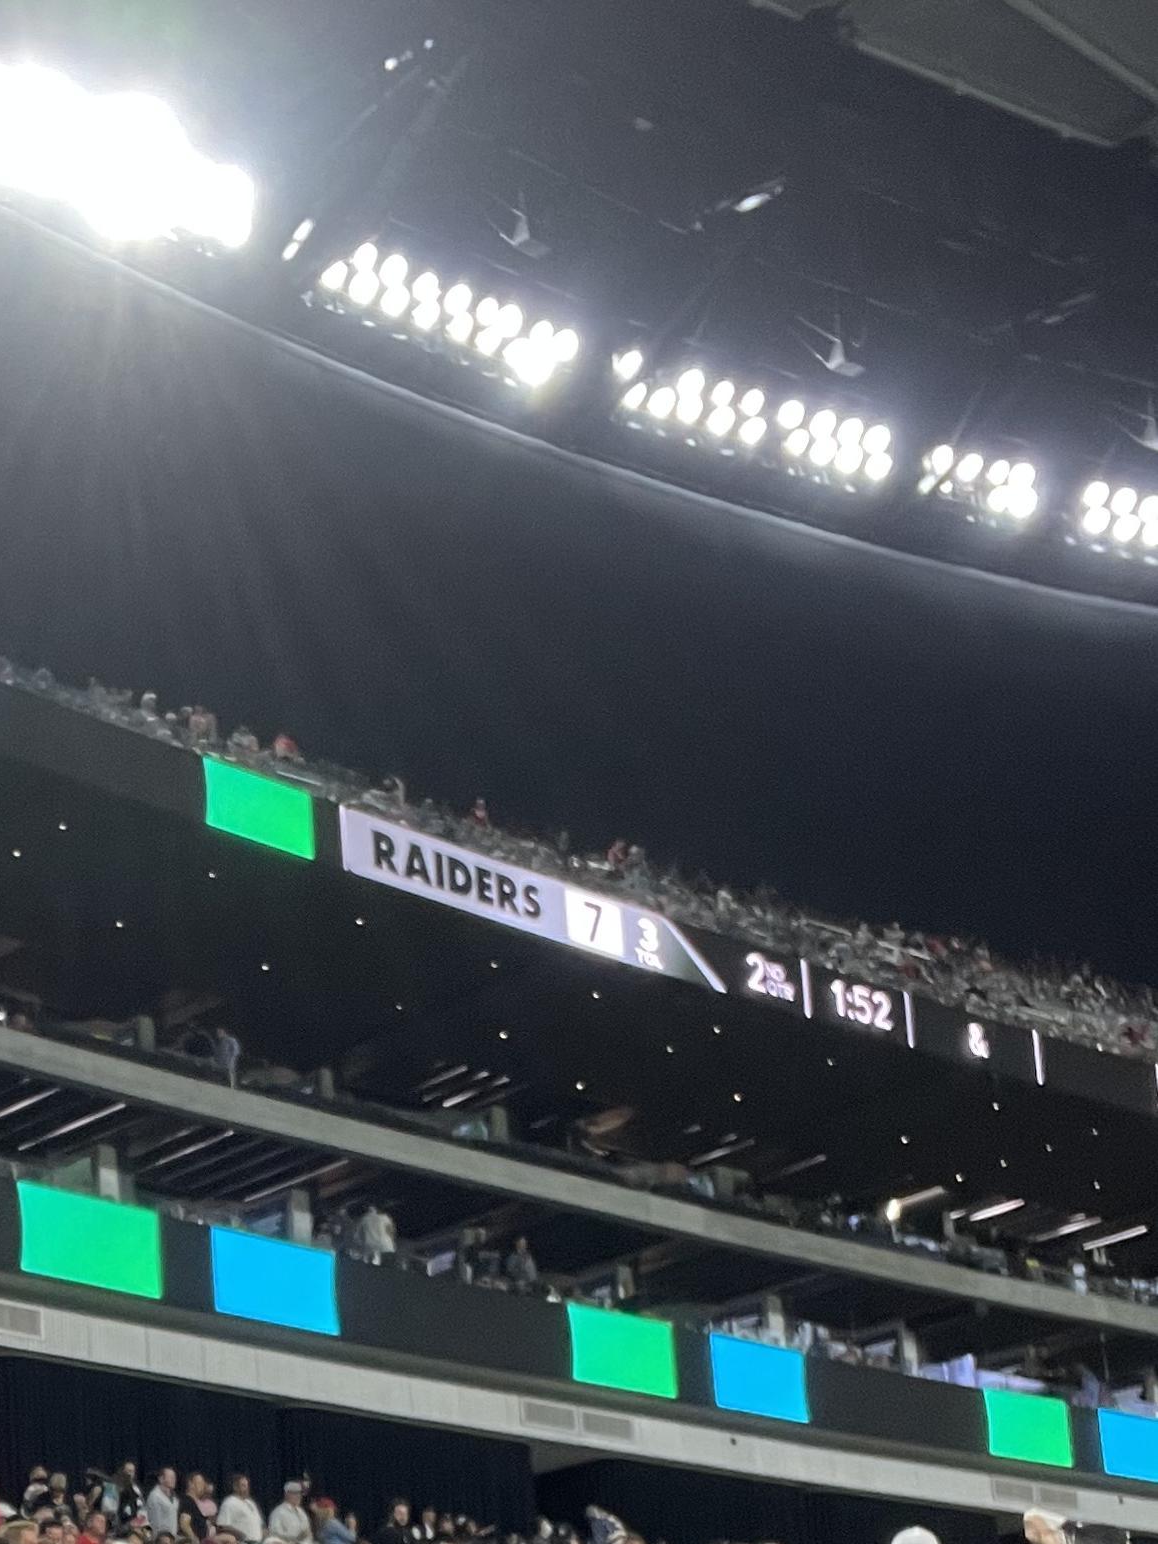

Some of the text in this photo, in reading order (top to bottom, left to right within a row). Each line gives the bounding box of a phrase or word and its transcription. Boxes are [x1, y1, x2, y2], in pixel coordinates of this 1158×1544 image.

[371, 829, 658, 951] RAIDERS 7 3
[830, 979, 893, 1031] 1:52
